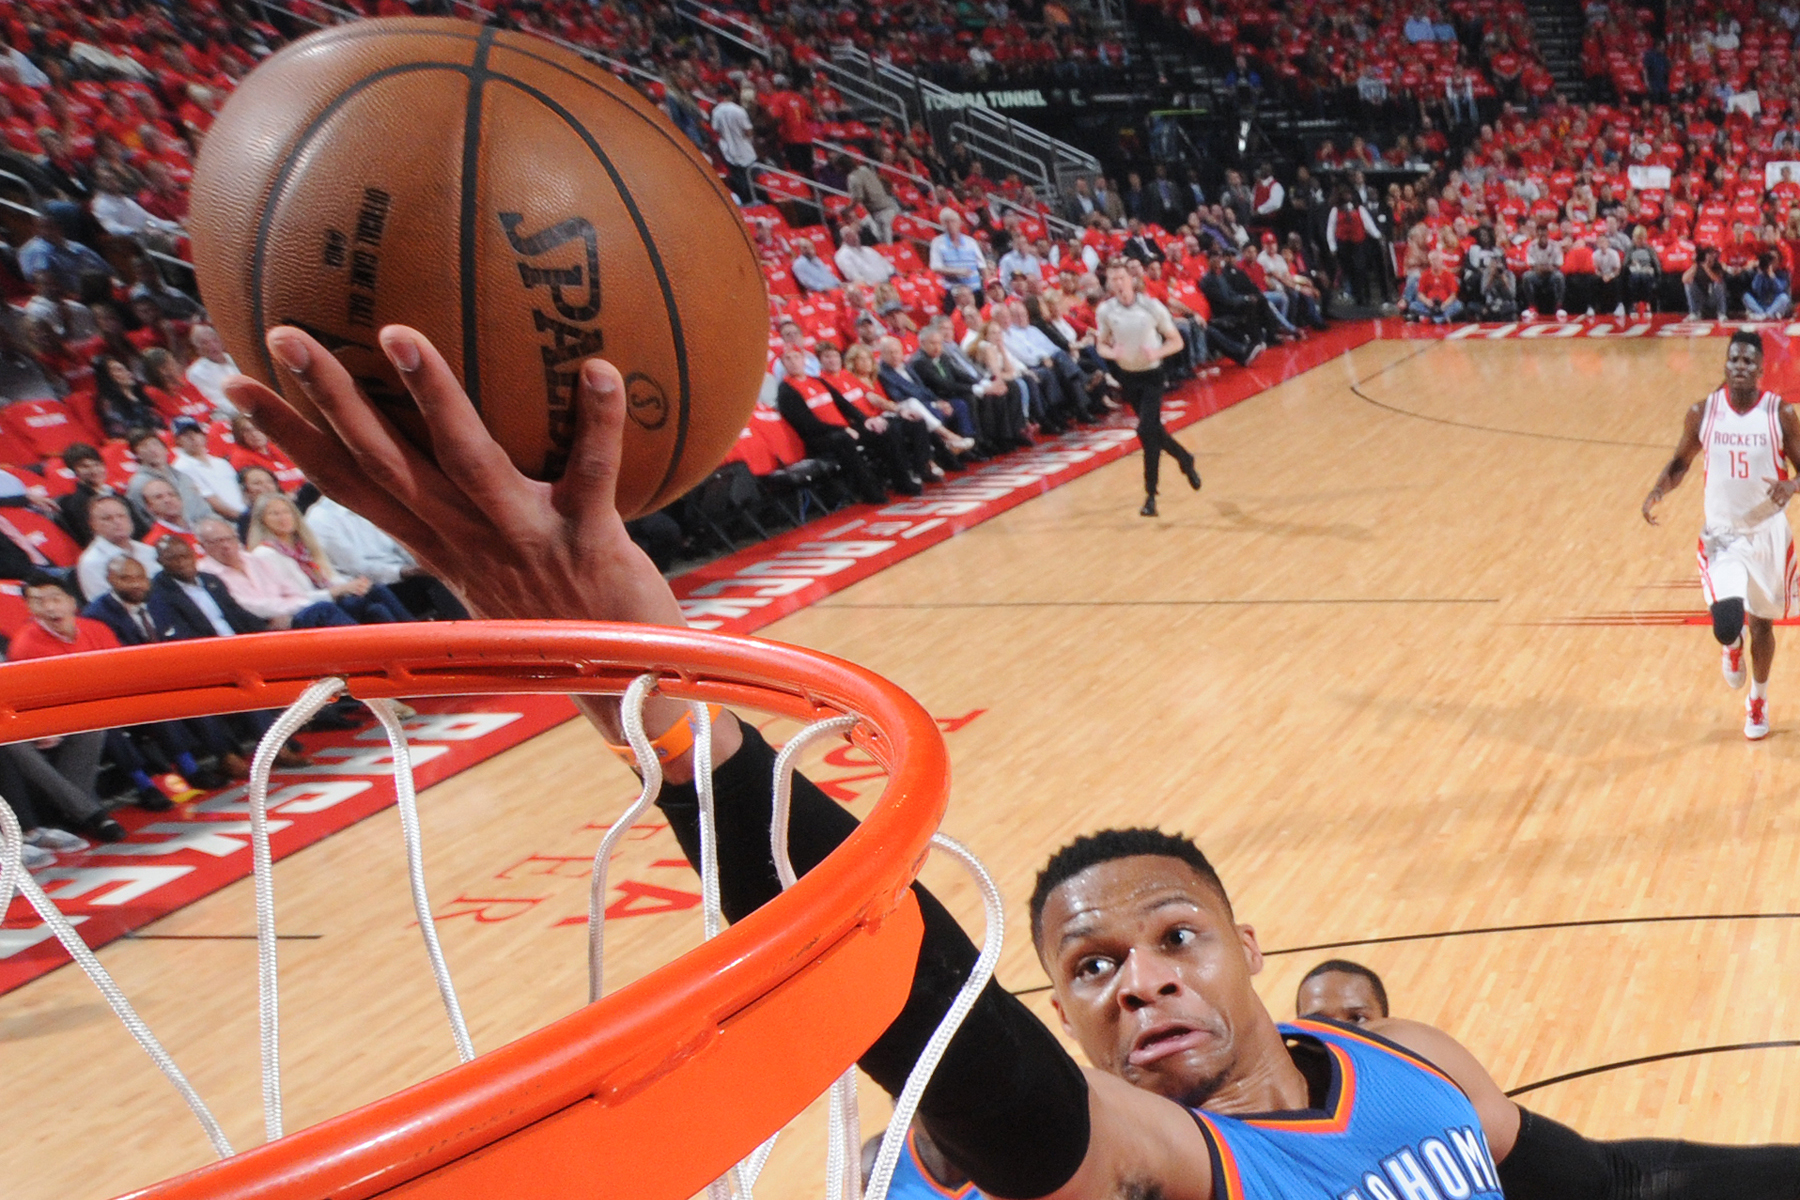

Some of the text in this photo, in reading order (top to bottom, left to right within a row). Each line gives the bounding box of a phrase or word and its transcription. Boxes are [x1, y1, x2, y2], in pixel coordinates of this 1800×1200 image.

[351, 250, 379, 290] GAME
[1713, 430, 1767, 446] ROCKETS
[1728, 450, 1750, 479] 15
